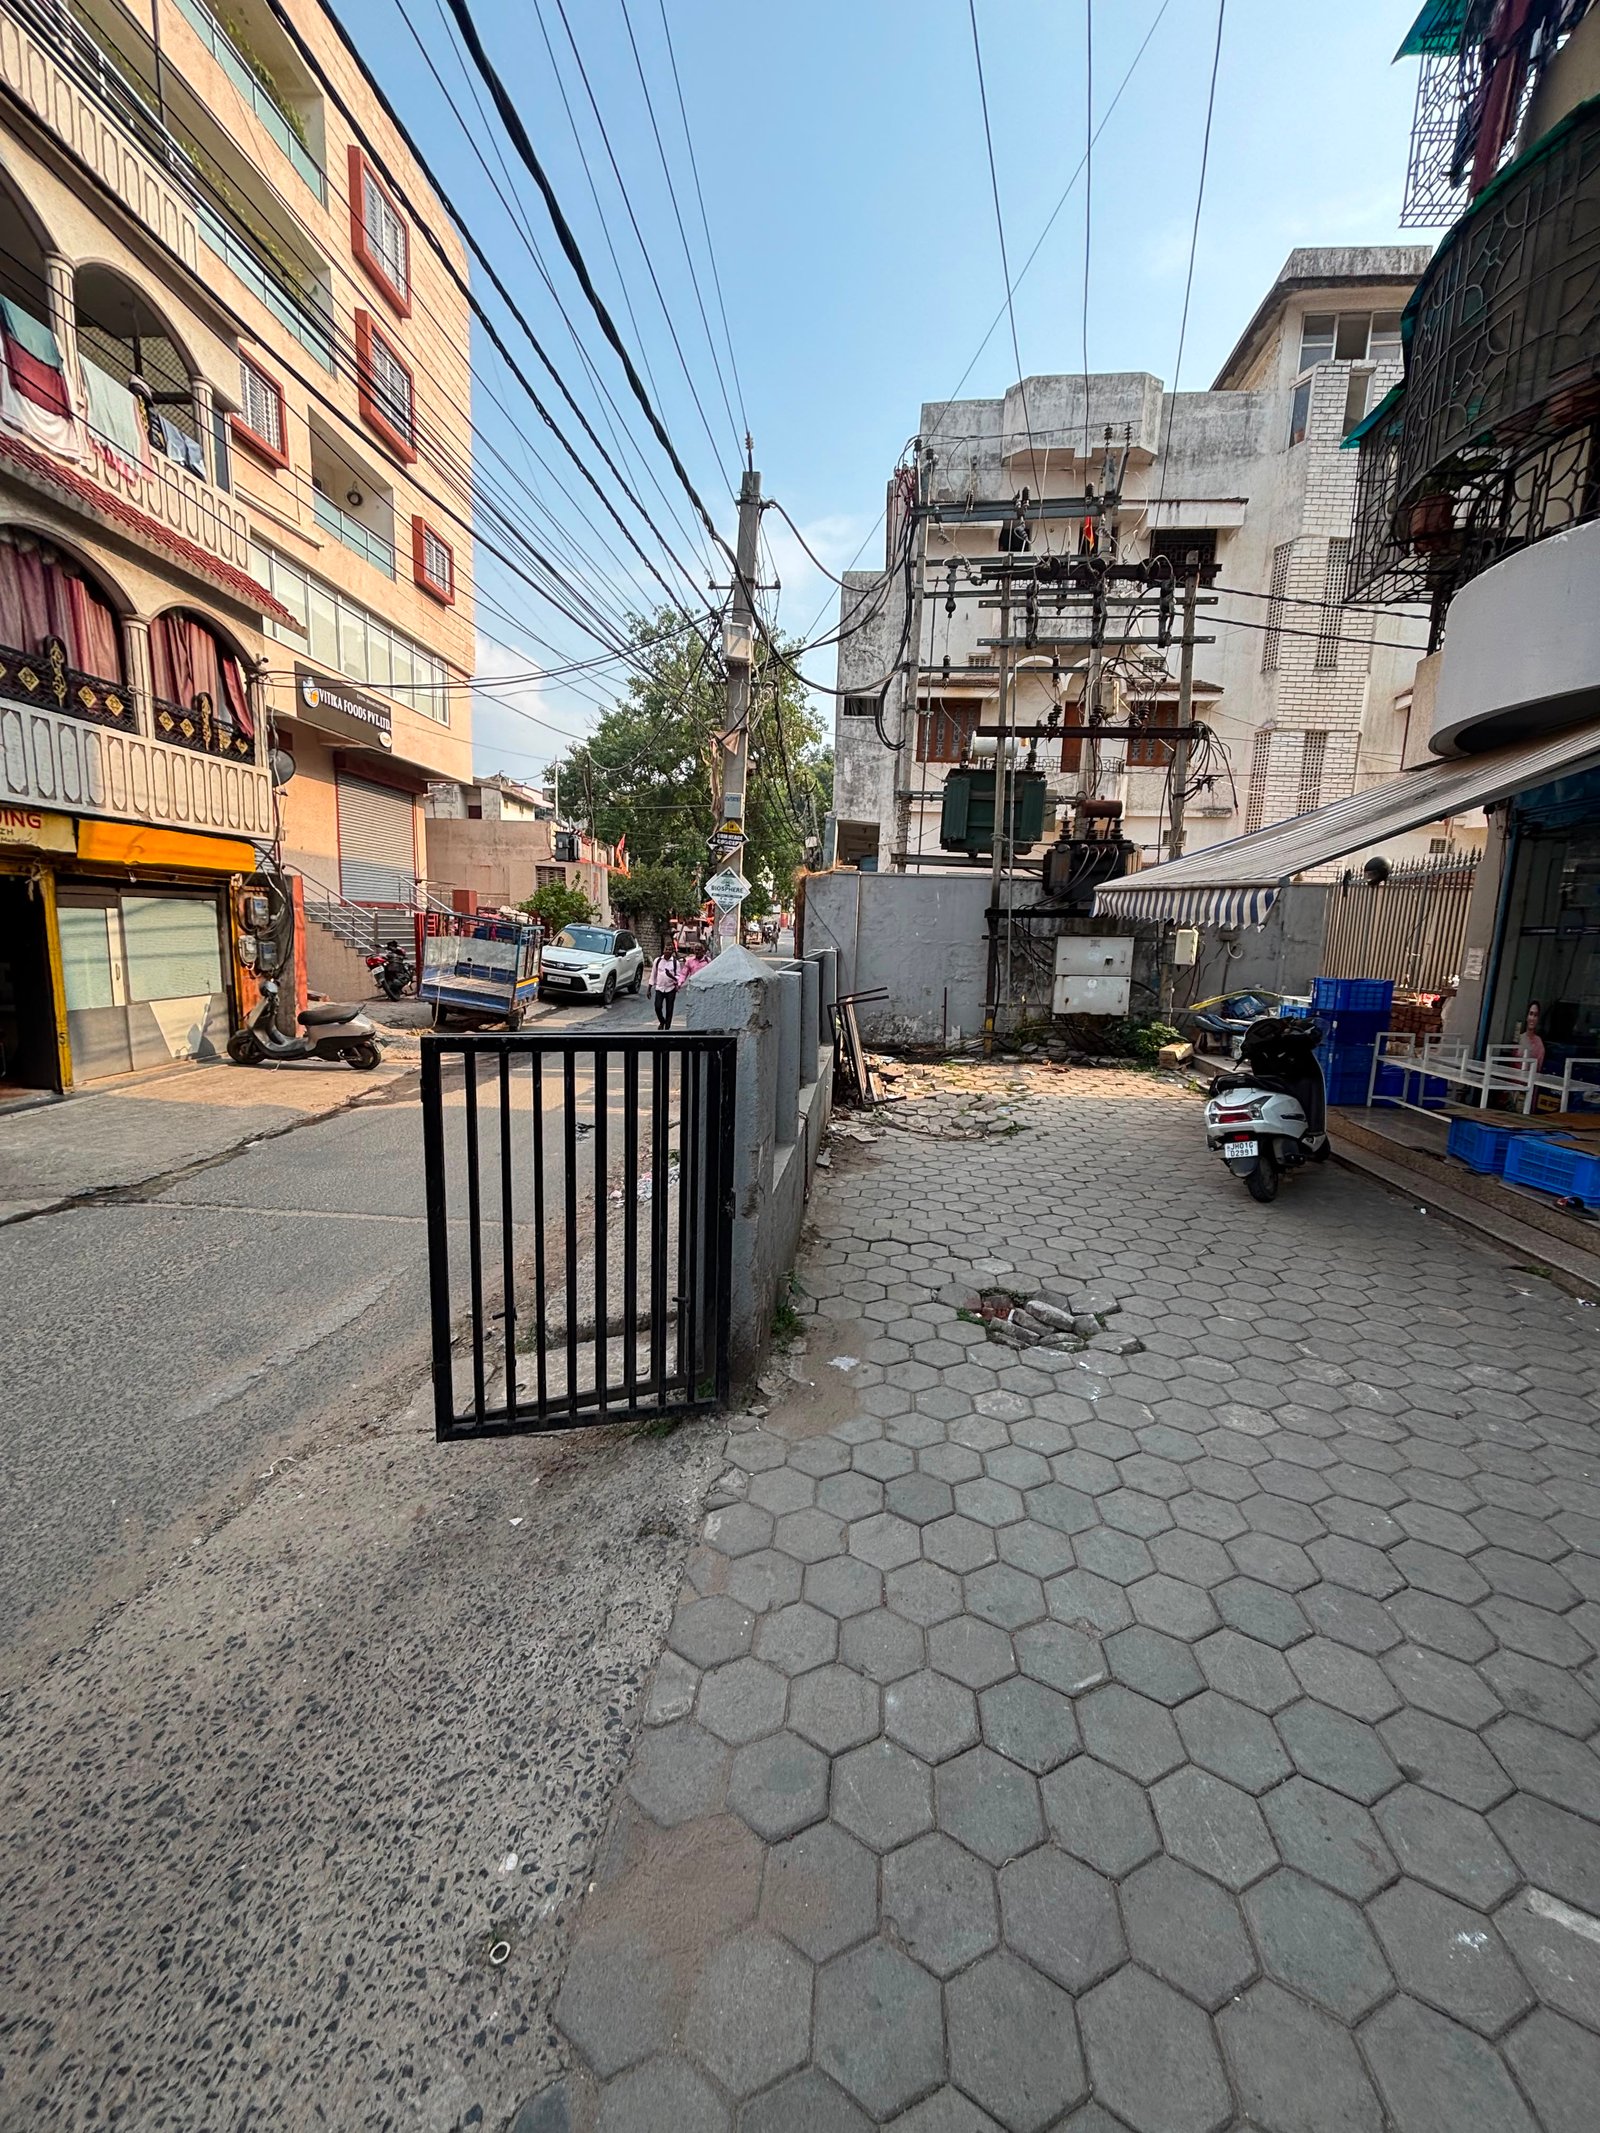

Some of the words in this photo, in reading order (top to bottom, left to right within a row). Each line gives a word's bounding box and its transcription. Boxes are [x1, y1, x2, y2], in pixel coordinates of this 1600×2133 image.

[319, 688, 343, 710] VITIKA
[343, 699, 367, 721] FOODS
[0, 809, 41, 829] ING
[711, 885, 744, 894] BIOSPHERE
